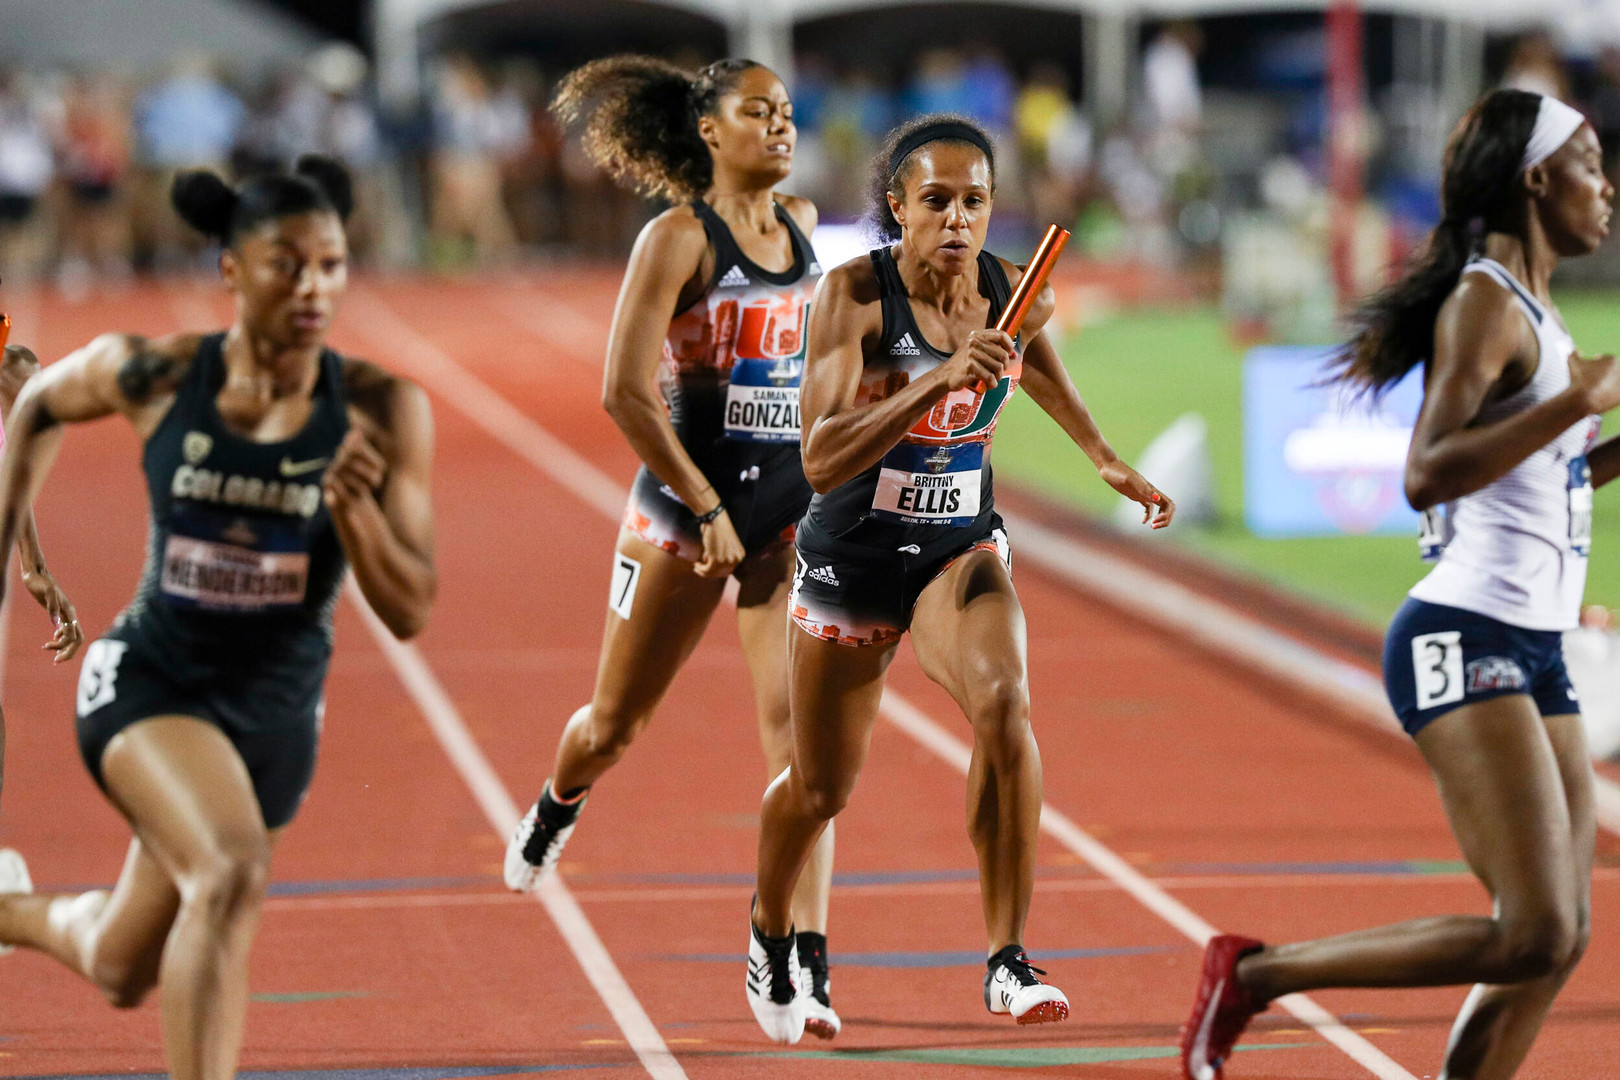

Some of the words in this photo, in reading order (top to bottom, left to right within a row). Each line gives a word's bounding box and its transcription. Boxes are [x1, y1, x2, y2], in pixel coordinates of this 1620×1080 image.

[889, 346, 921, 355] adidas
[171, 464, 321, 518] COLORADO
[913, 475, 955, 488] BRITTNY
[896, 486, 961, 514] ELLIS
[620, 561, 635, 609] 7
[808, 570, 840, 587] adidas
[1425, 640, 1449, 700] 3
